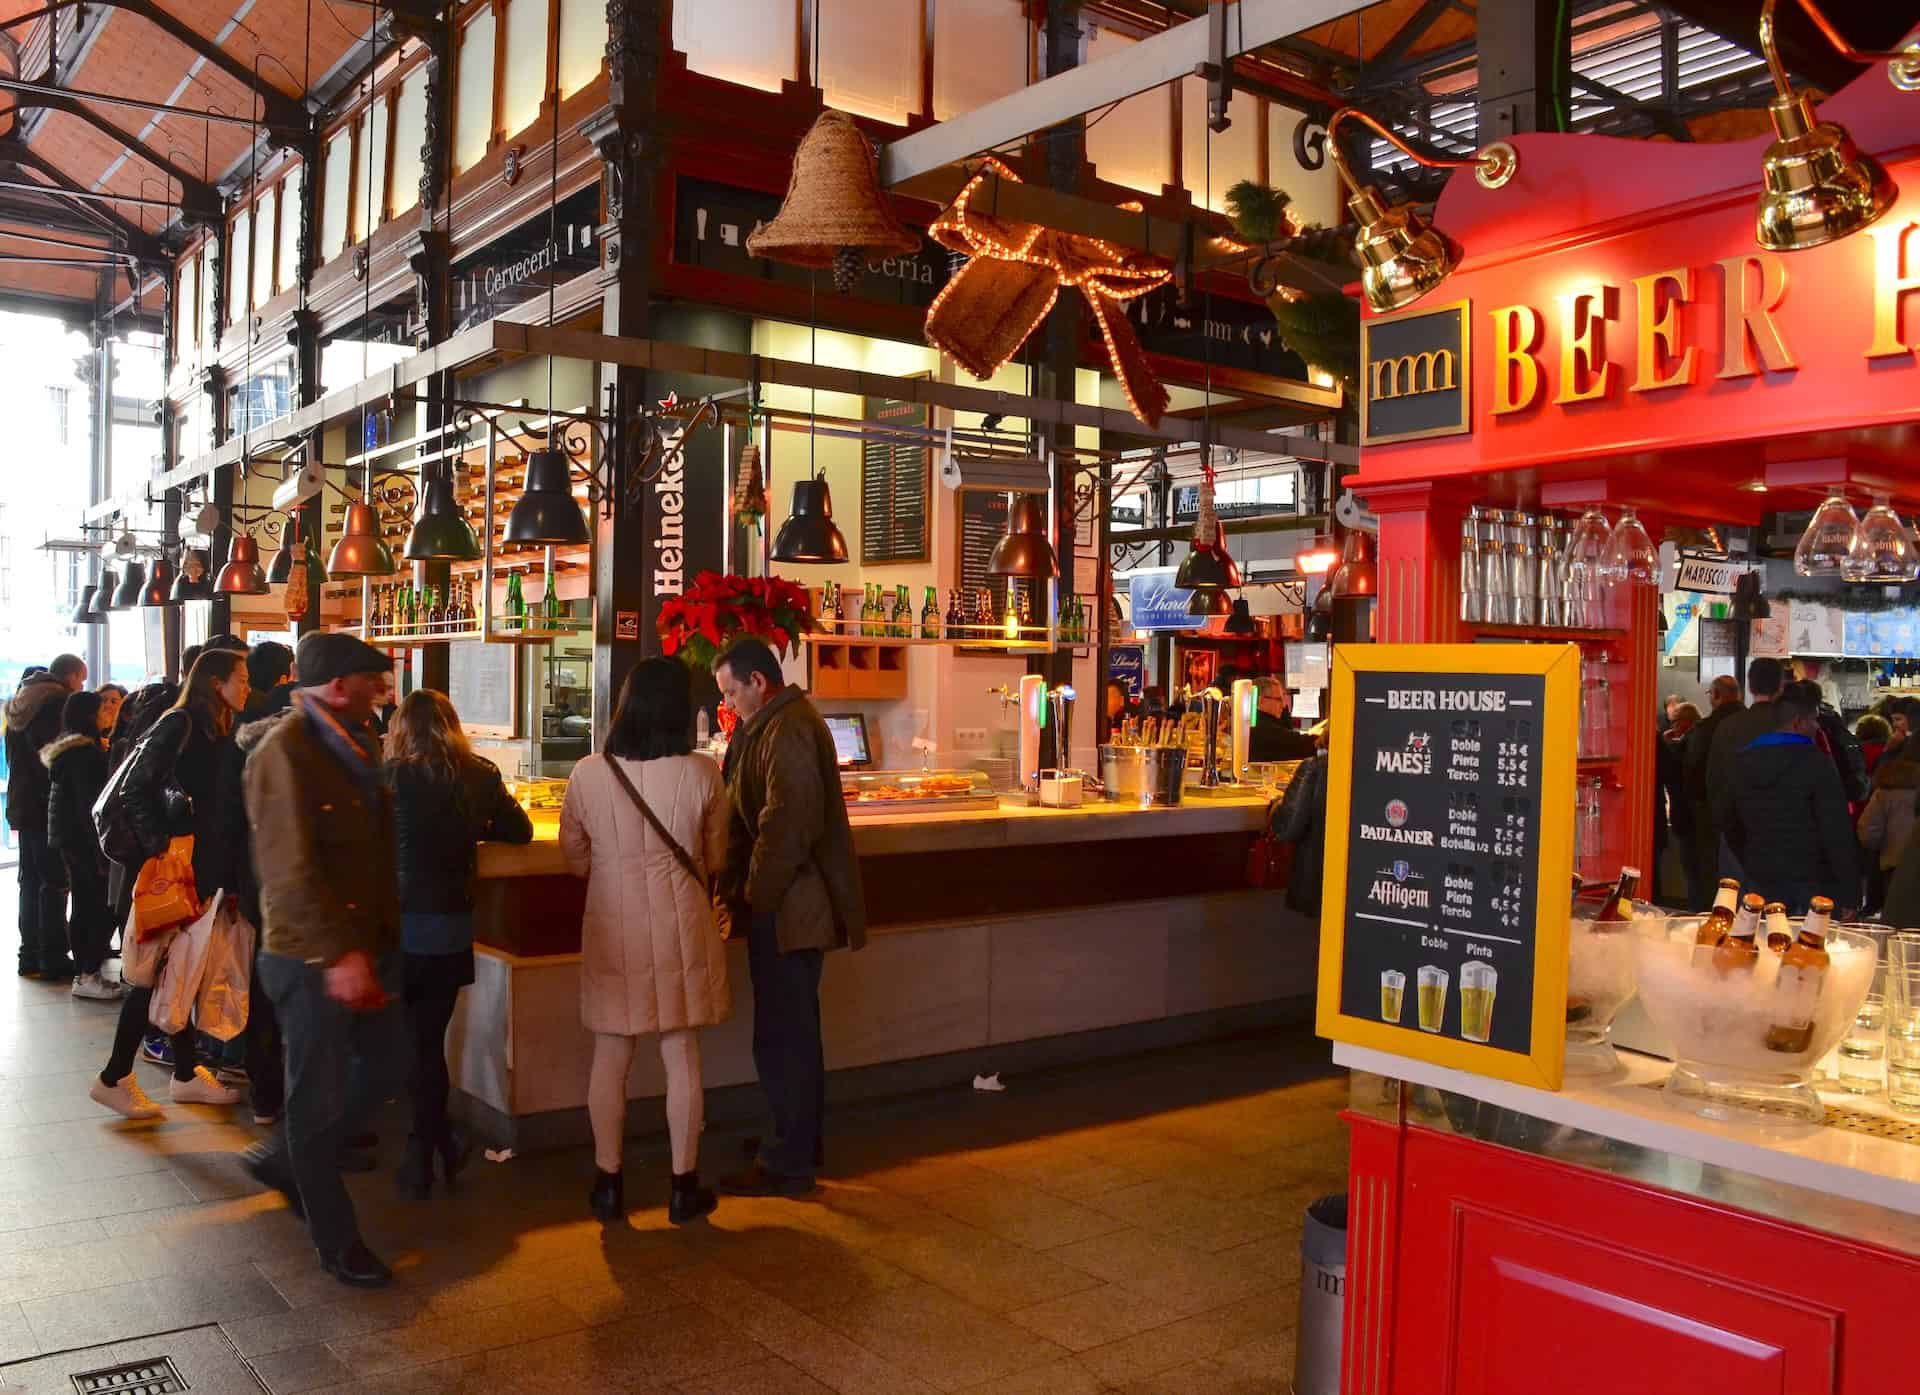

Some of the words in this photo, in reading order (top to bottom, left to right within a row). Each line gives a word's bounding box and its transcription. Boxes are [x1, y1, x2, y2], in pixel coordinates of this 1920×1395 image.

[1489, 253, 1798, 416] BEER
[1682, 564, 1729, 587] MARISCOS
[1138, 583, 1193, 613] Lhard
[1387, 689, 1436, 710] BEER
[1439, 690, 1506, 712] HOUSE
[1451, 738, 1481, 752] Doble
[1375, 751, 1423, 774] MAES
[1452, 753, 1480, 768] Pinta
[1446, 768, 1480, 782] Tercio
[1448, 808, 1478, 822] Doble
[1360, 824, 1434, 848] PAULANER
[1449, 822, 1477, 837] Pinta
[1444, 875, 1473, 891] Doble
[1367, 880, 1430, 910] Affligem
[1446, 890, 1473, 905] Pinta
[1441, 904, 1472, 919] Tercio
[1421, 935, 1449, 951] Doble
[1466, 943, 1493, 958] Pinta
